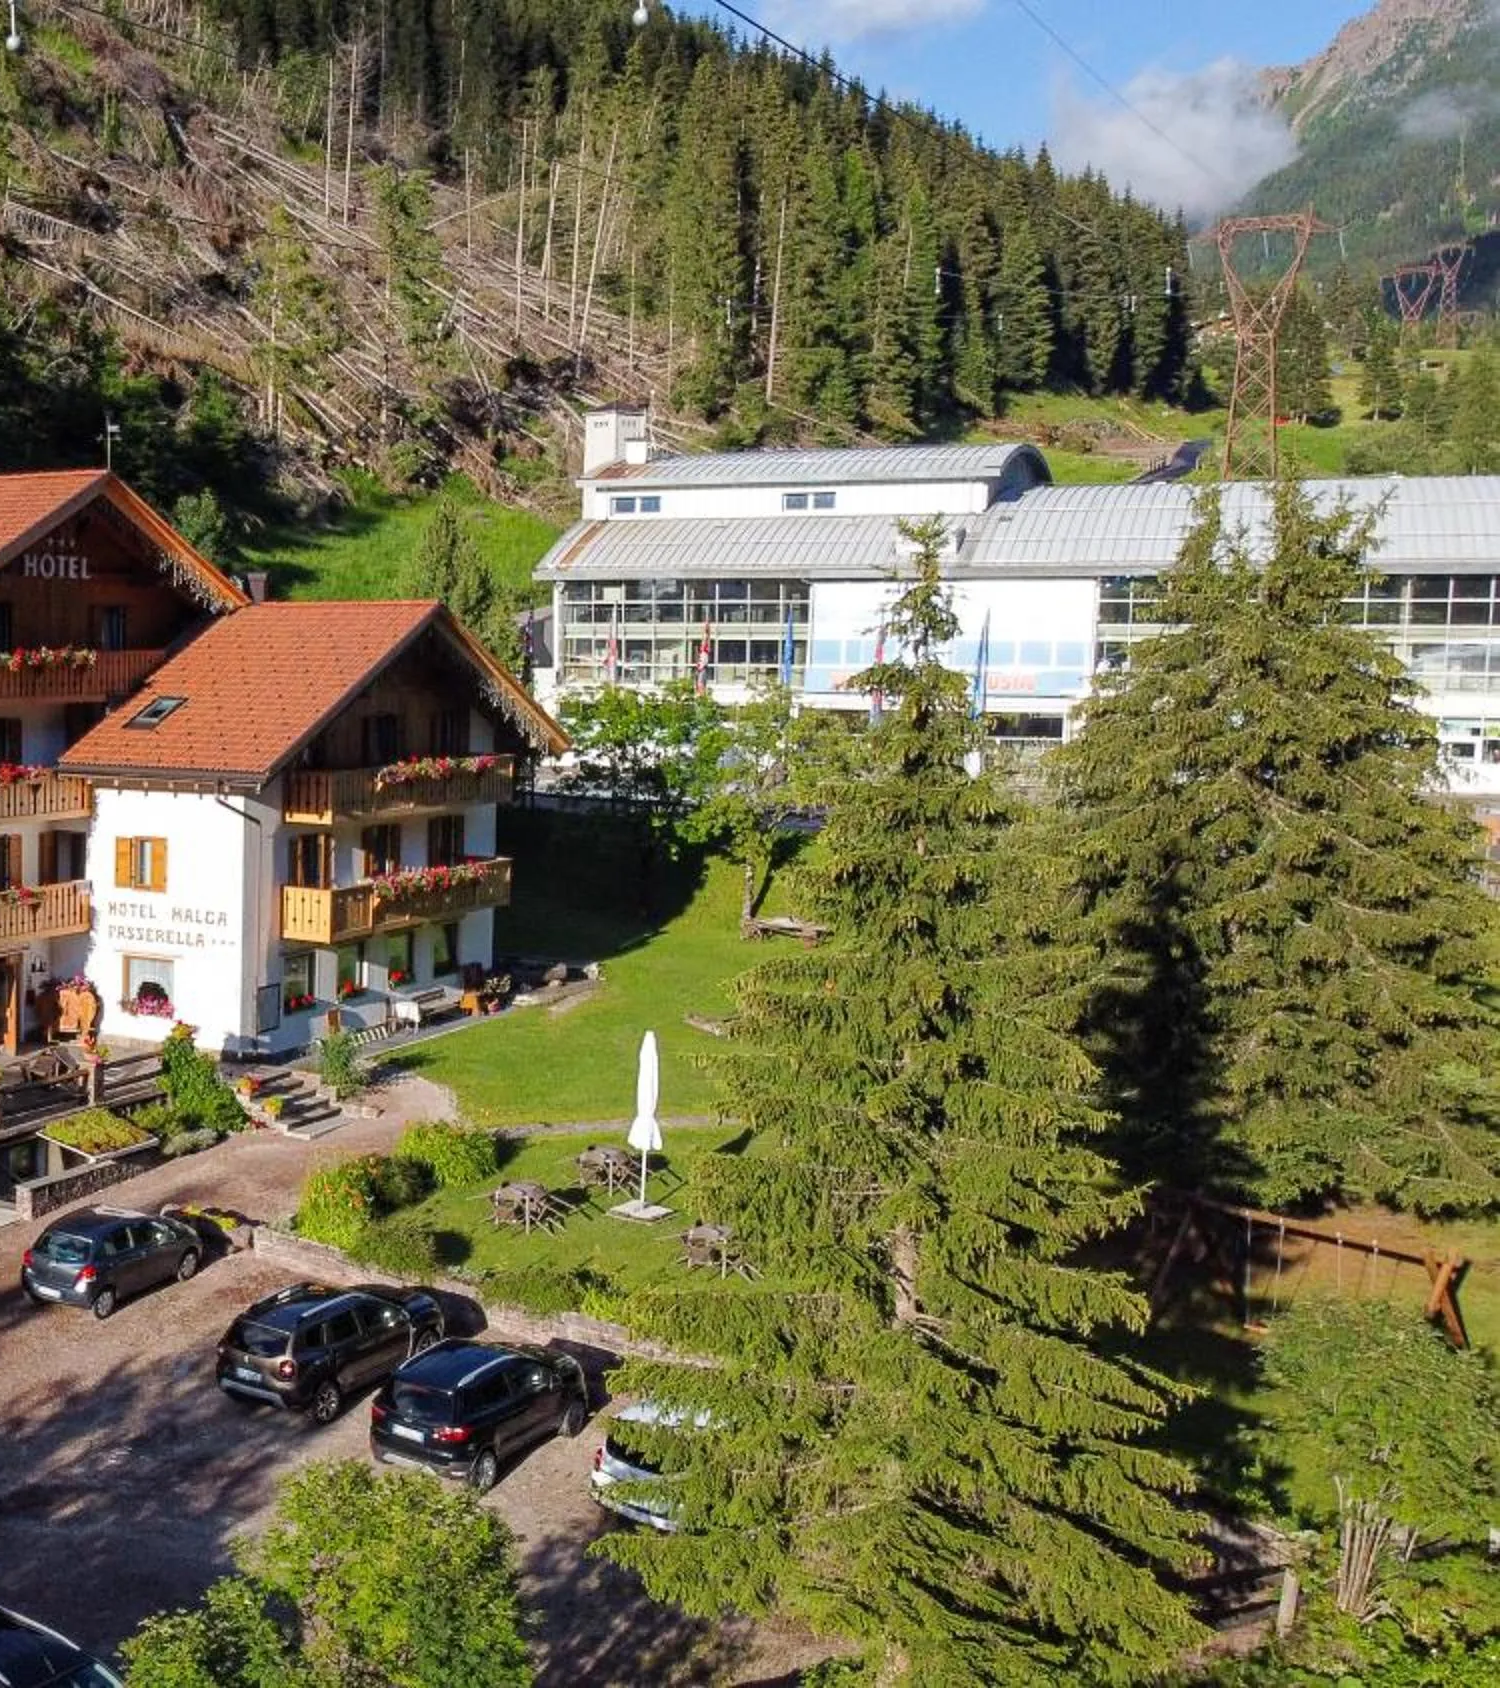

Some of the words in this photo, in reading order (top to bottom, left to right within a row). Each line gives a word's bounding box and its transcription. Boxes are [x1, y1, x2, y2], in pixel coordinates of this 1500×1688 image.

[23, 553, 92, 579] HOTEL
[108, 901, 156, 919] HOTEL
[108, 924, 205, 947] PASSERELLA
